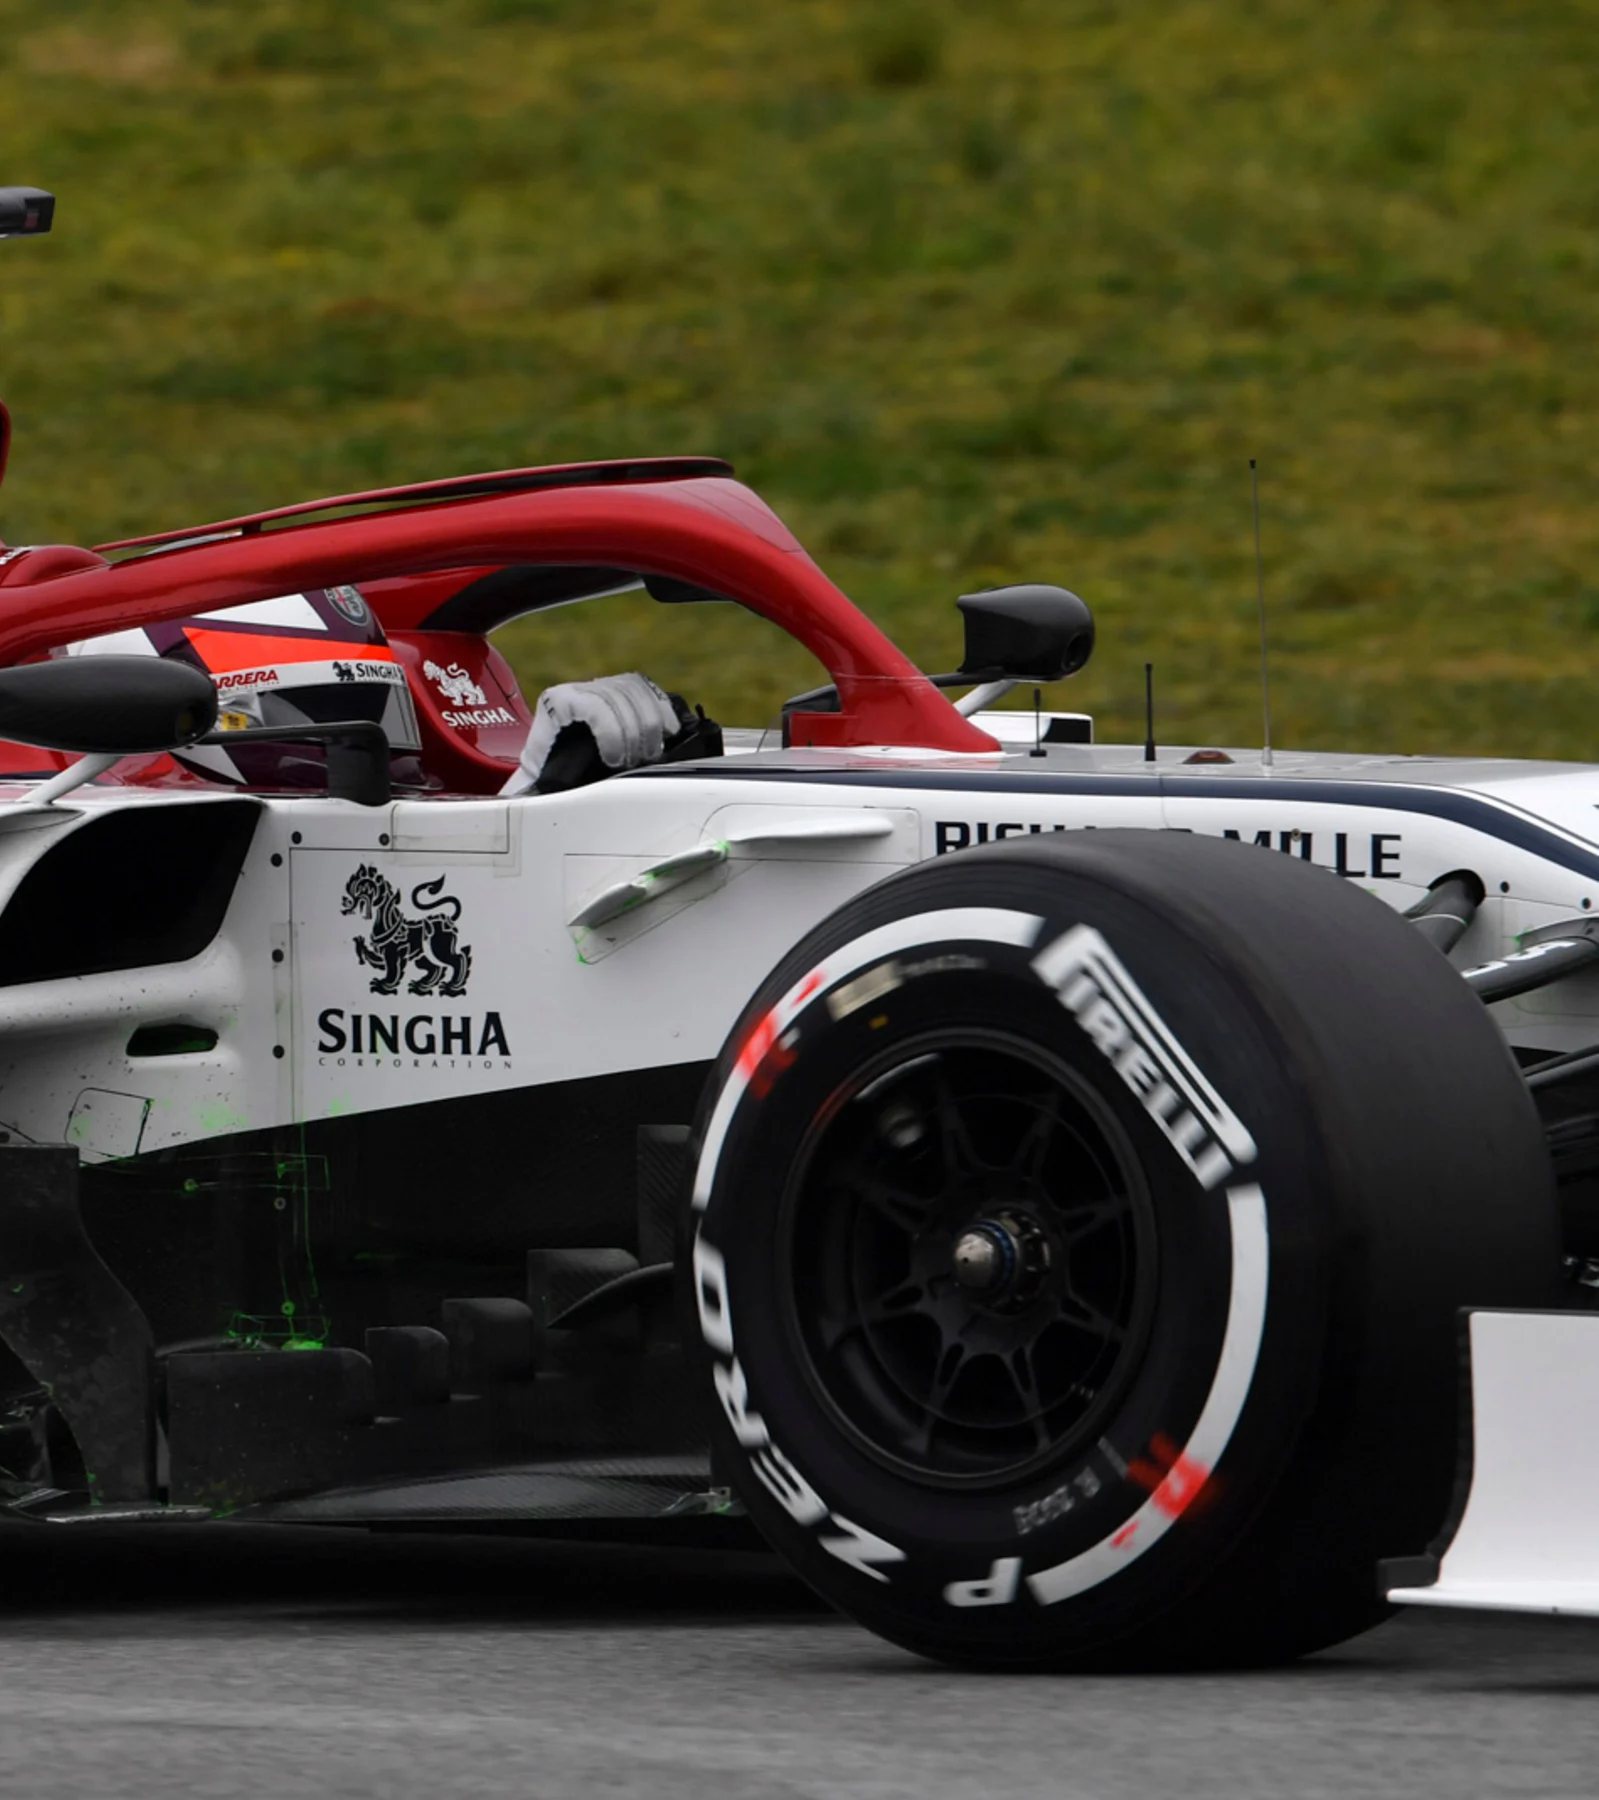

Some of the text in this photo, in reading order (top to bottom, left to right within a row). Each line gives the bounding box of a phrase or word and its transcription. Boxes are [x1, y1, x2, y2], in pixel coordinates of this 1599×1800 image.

[212, 669, 278, 690] RRERA
[441, 706, 517, 727] SINGHA
[317, 1008, 511, 1056] SINGHA
[319, 1058, 512, 1069] CORPORATION
[1029, 922, 1258, 1191] PIRELLI
